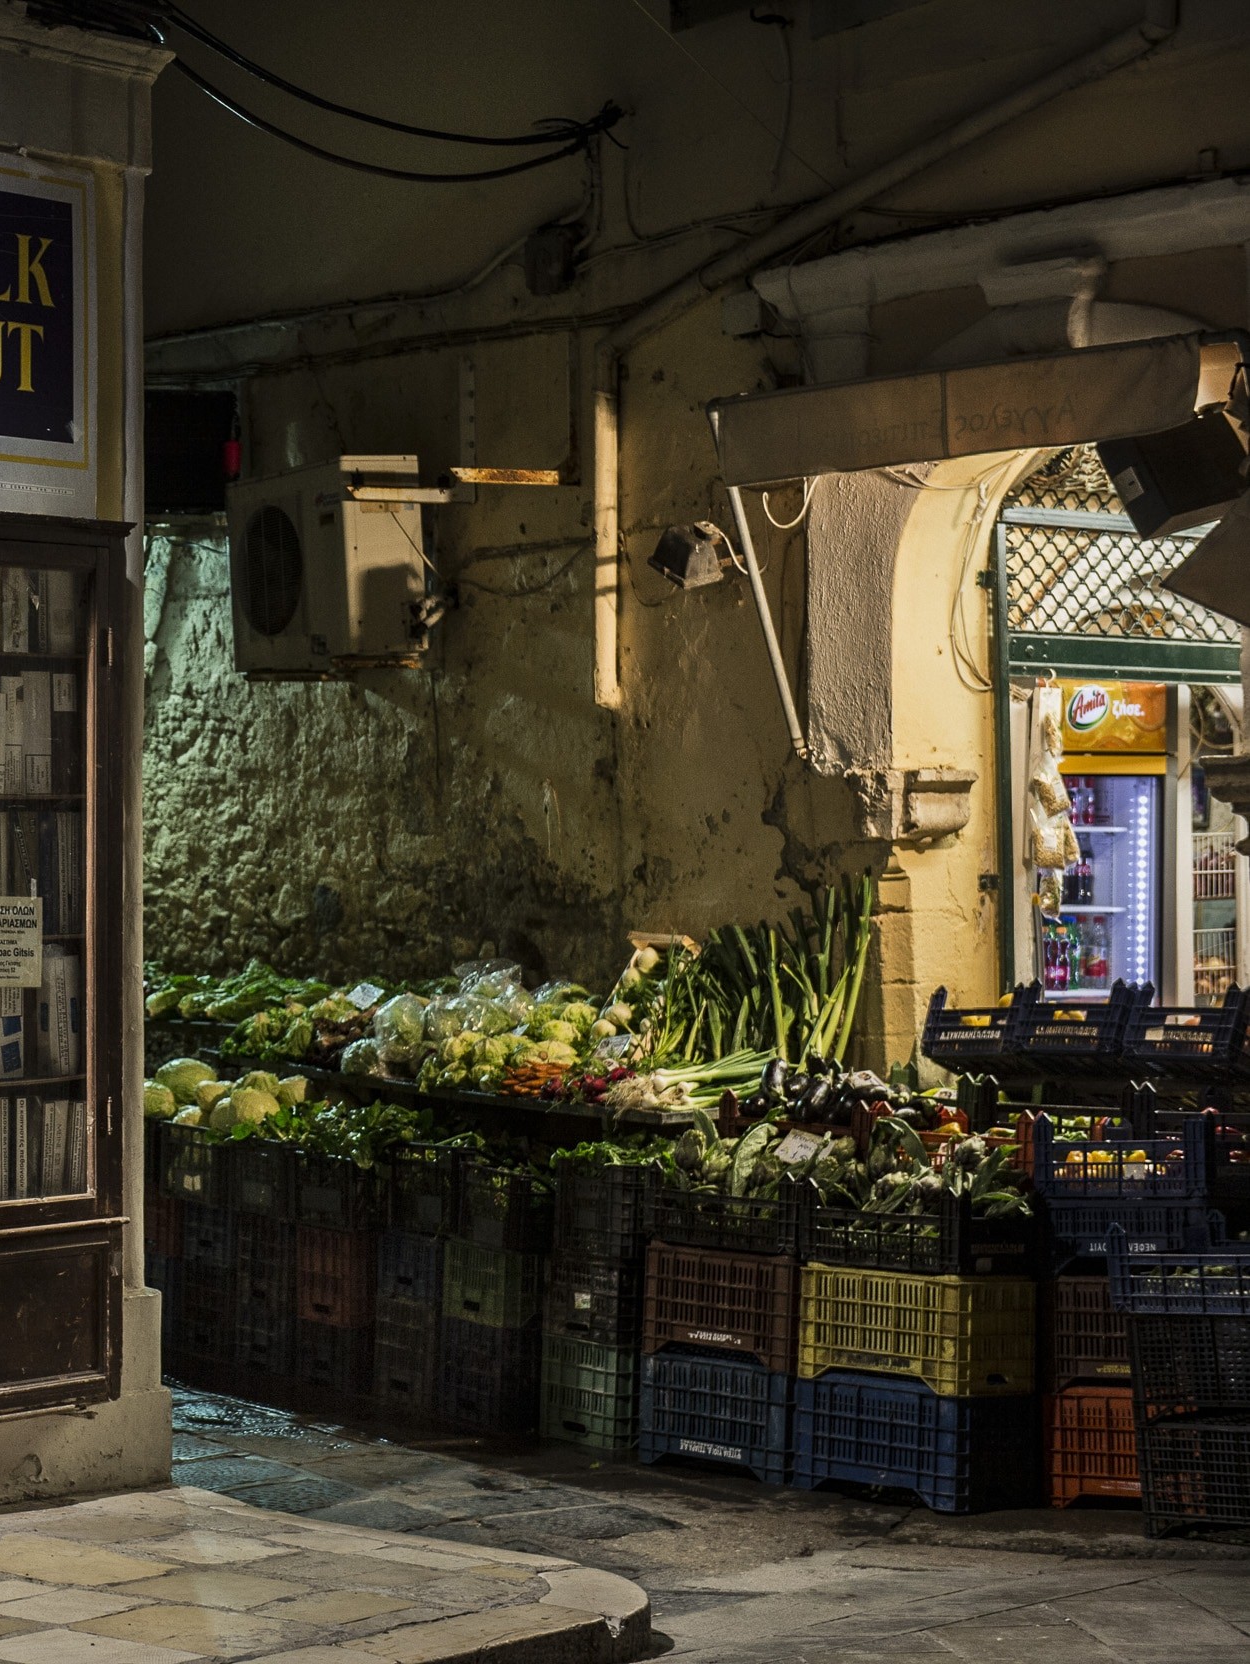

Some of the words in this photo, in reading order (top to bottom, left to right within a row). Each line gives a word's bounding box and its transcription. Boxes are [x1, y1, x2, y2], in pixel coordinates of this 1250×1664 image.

[1071, 690, 1107, 725] Amita
[1111, 698, 1146, 720] ζήσε.
[11, 905, 35, 916] ΟΛΩΝ
[13, 948, 35, 957] Gitsis
